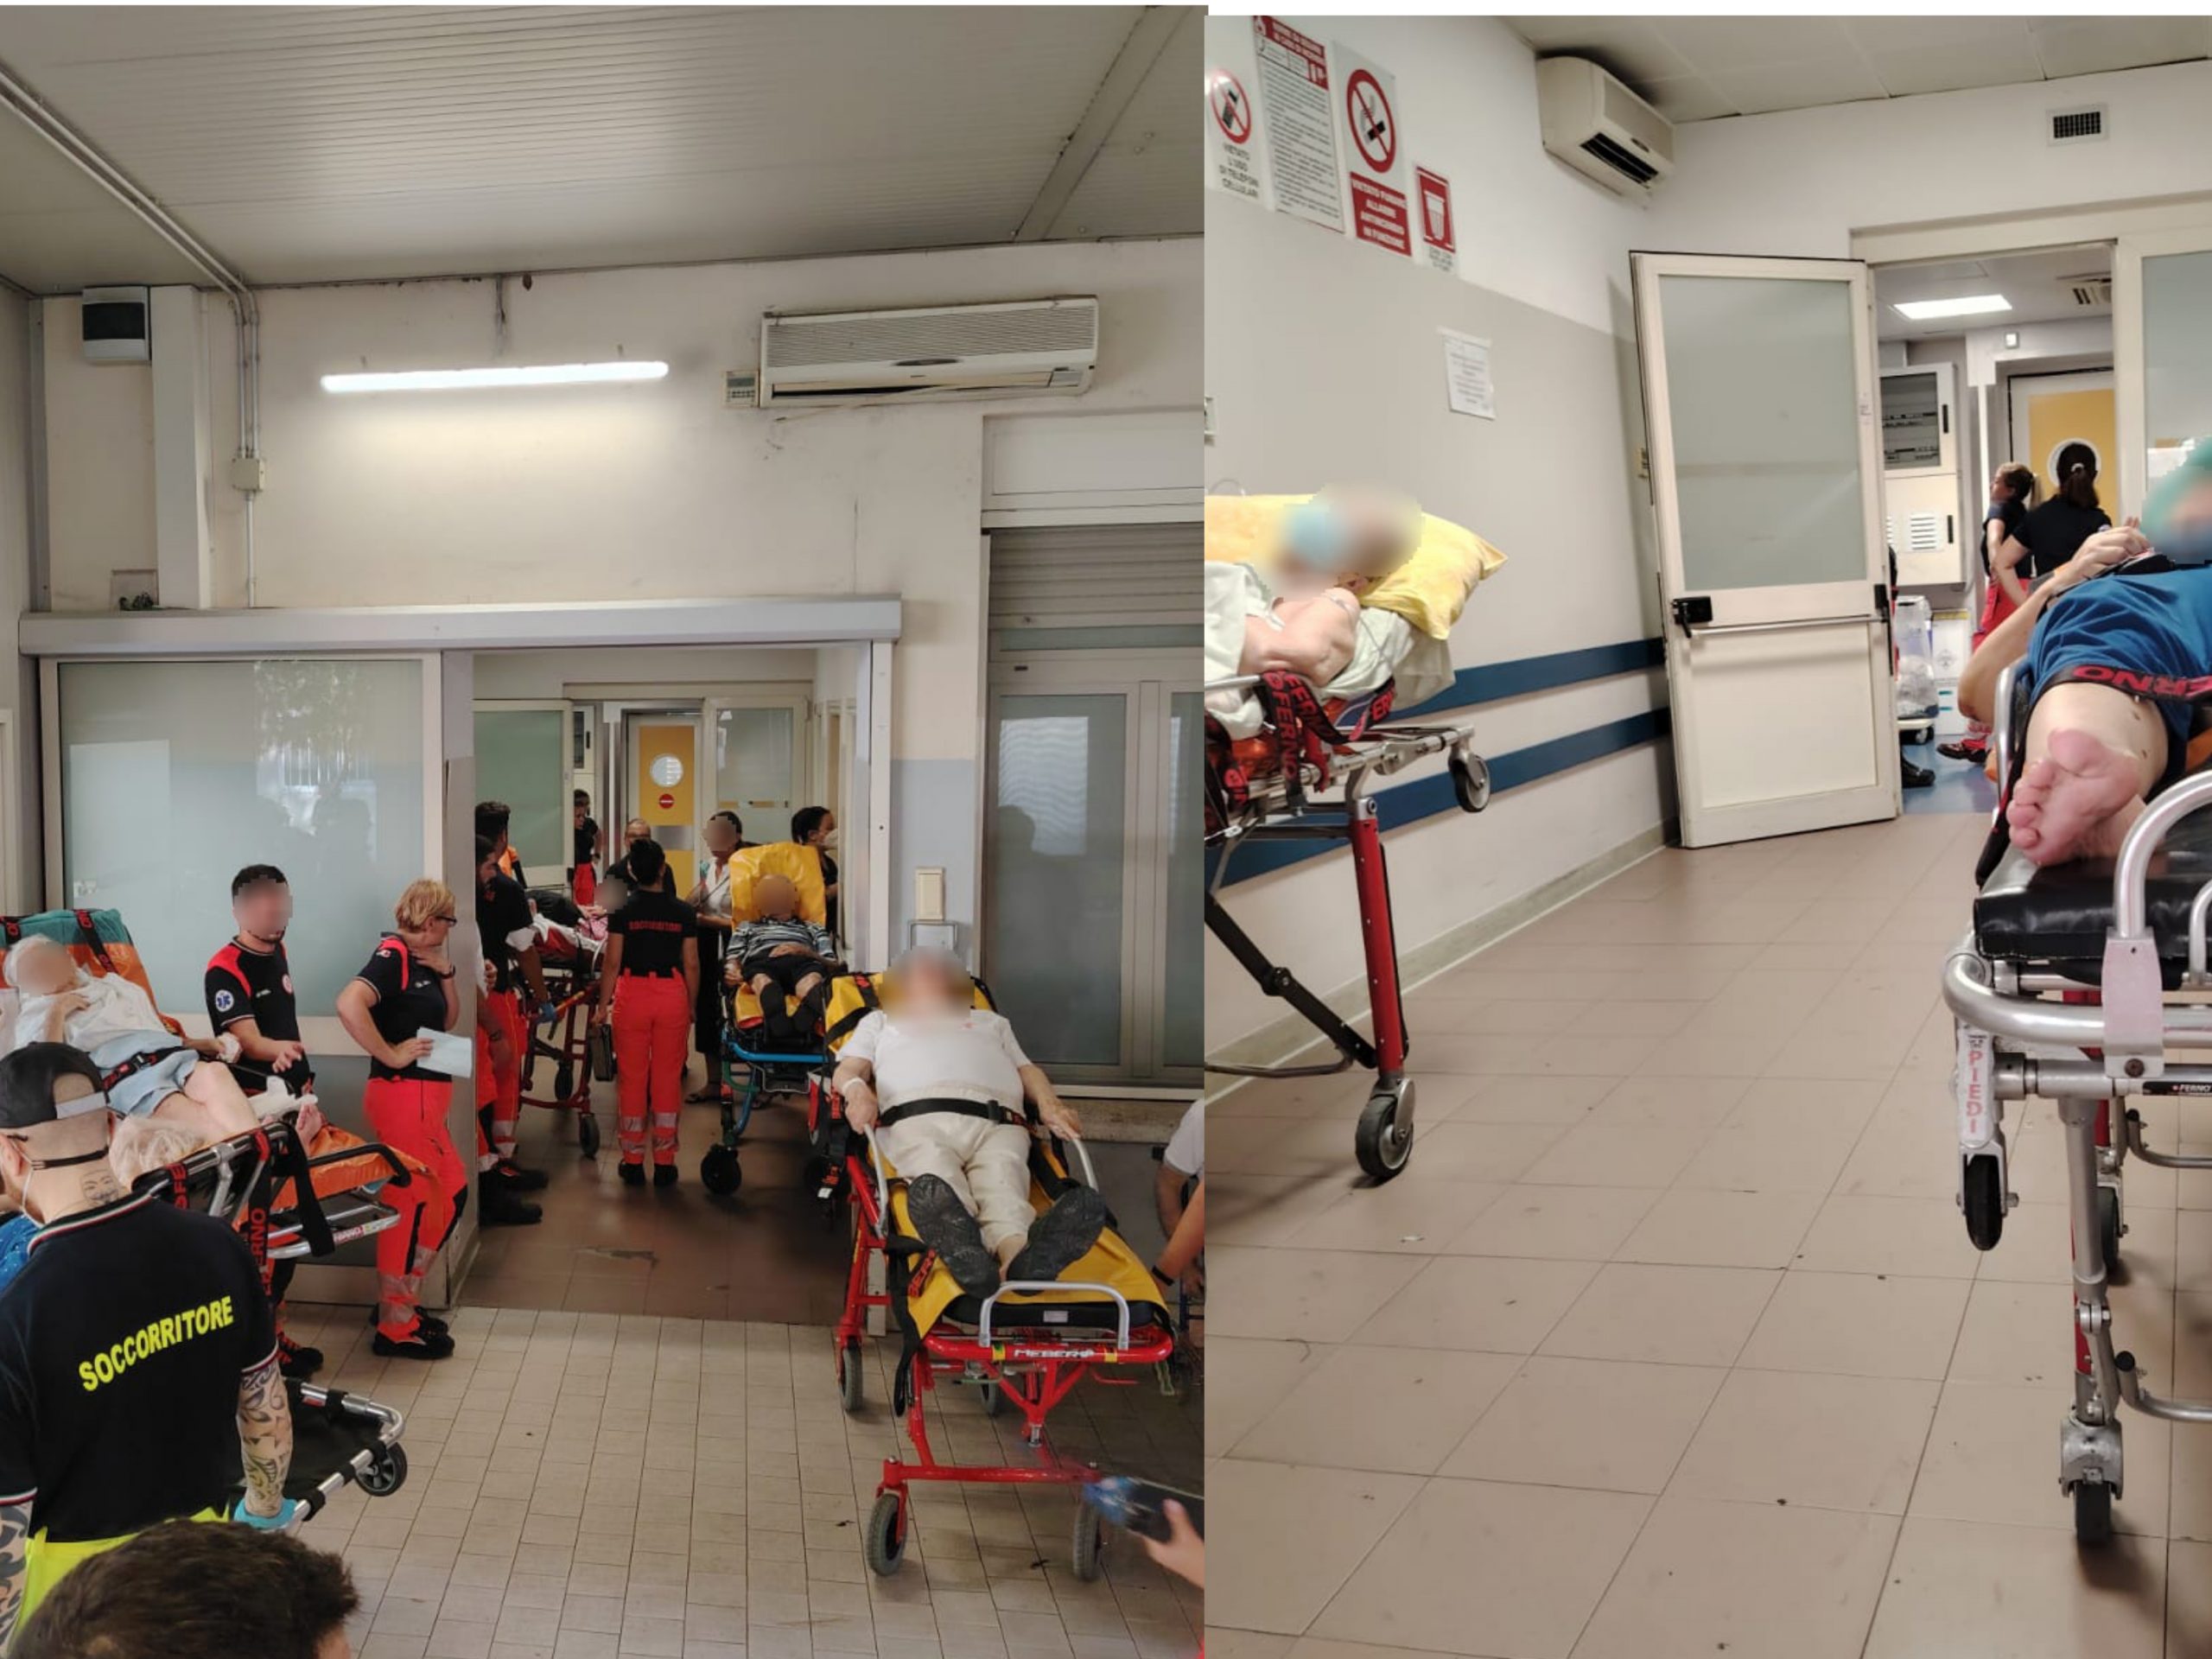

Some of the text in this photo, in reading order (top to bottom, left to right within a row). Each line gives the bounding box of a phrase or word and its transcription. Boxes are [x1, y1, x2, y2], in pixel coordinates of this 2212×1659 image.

[2073, 664, 2212, 696] ERNO
[1967, 1050, 1984, 1134] PIEDI
[79, 1295, 234, 1392] SOCCORRITORE
